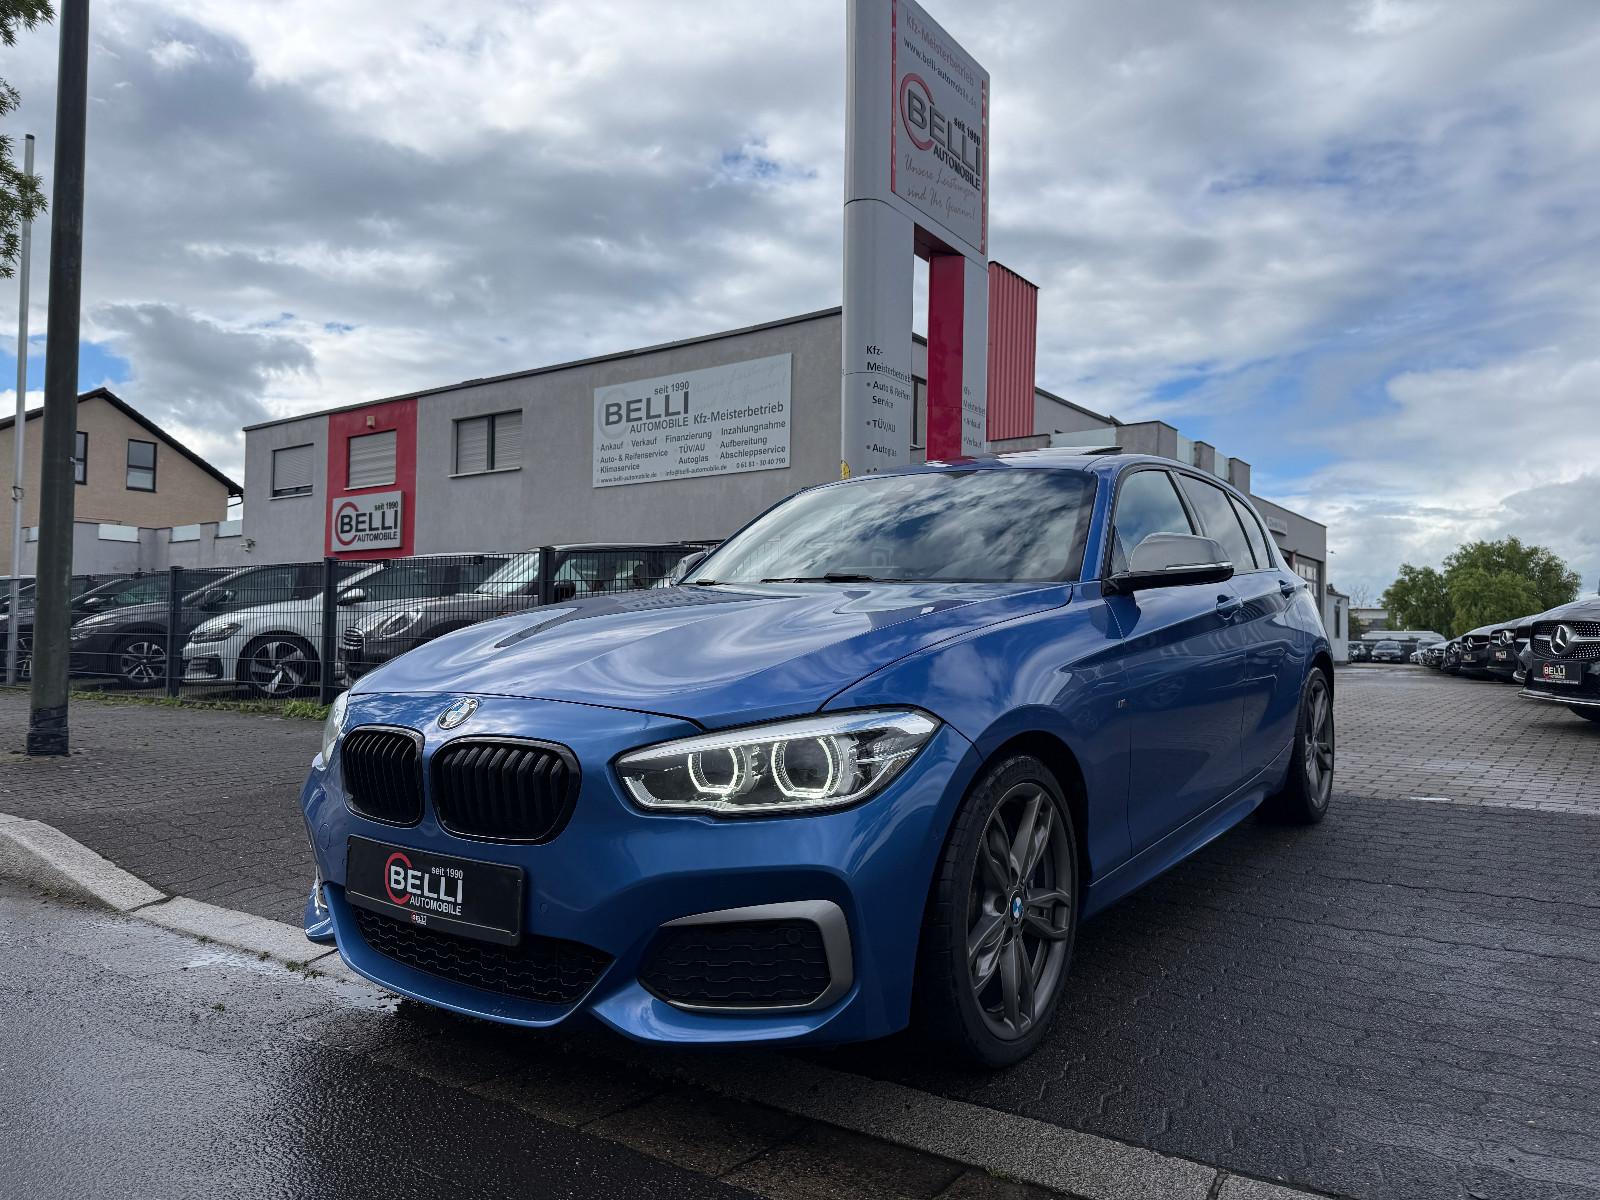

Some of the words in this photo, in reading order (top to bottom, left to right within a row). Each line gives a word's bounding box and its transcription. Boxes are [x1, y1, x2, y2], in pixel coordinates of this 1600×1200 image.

[906, 14, 975, 87] Kfz-Meisterbetrieb
[908, 89, 981, 176] BELLI
[933, 144, 981, 191] AUTOMOBILE
[866, 345, 883, 356] Kfz-
[654, 385, 669, 395] seit
[671, 381, 689, 392] 1990
[605, 391, 689, 426] BELLI
[693, 401, 784, 425] Kfz-Meisterbetrieb
[630, 417, 689, 434] AUTOMOBILE
[600, 441, 624, 452] Ankauf
[631, 437, 657, 448] Verkauf
[665, 431, 712, 443] Finanzierung
[721, 420, 786, 435] Inzahlungnahme
[720, 436, 767, 449] Aufbereitung
[625, 449, 669, 461] Reifenservice
[679, 443, 706, 454] TÜV/AU
[720, 445, 786, 460] Abschleppservice
[678, 454, 709, 465] Autoglas
[600, 463, 640, 474] Klimaservice
[340, 510, 398, 534] BELLI
[357, 531, 398, 542] AUTOMOBILE
[431, 866, 444, 876] seit
[446, 868, 463, 880] 1990
[390, 865, 463, 904] BELLI
[410, 895, 462, 916] AUTOMOBILE
